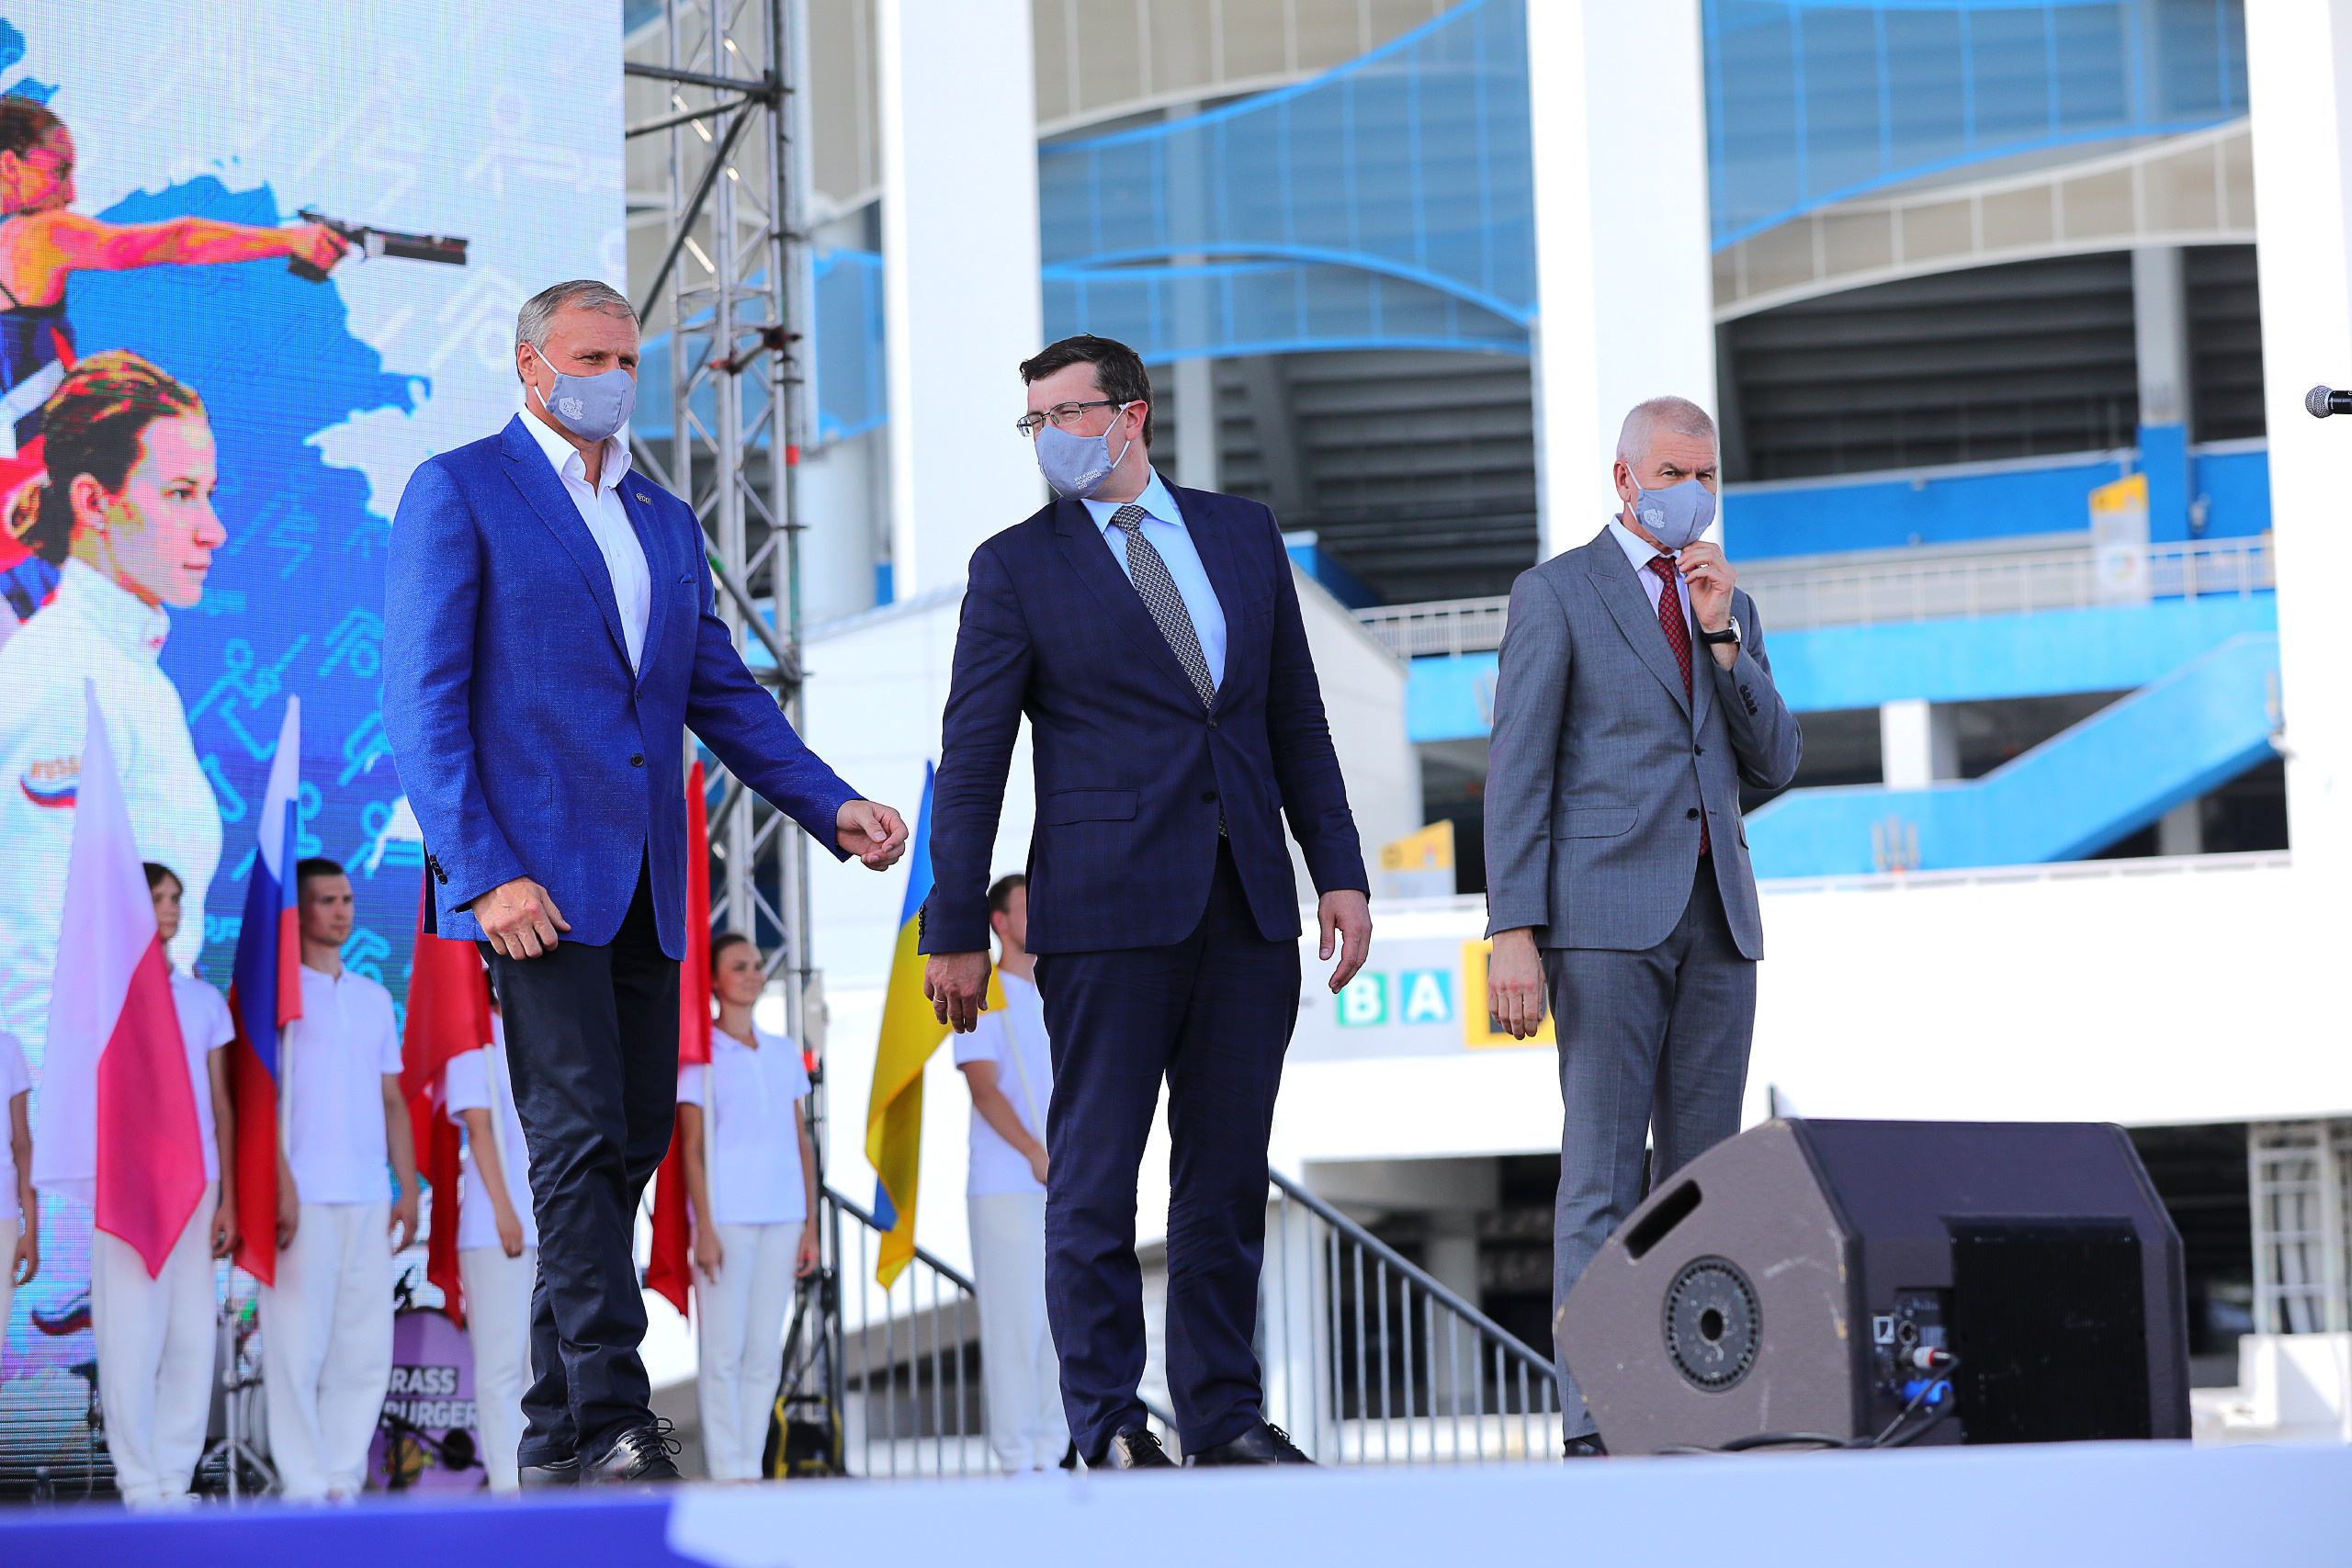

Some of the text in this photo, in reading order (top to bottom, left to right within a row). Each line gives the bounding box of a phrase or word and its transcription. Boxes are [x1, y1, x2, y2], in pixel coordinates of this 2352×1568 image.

[1342, 974, 1382, 1023] B
[1406, 971, 1449, 1022] A
[390, 1366, 457, 1395] RASS
